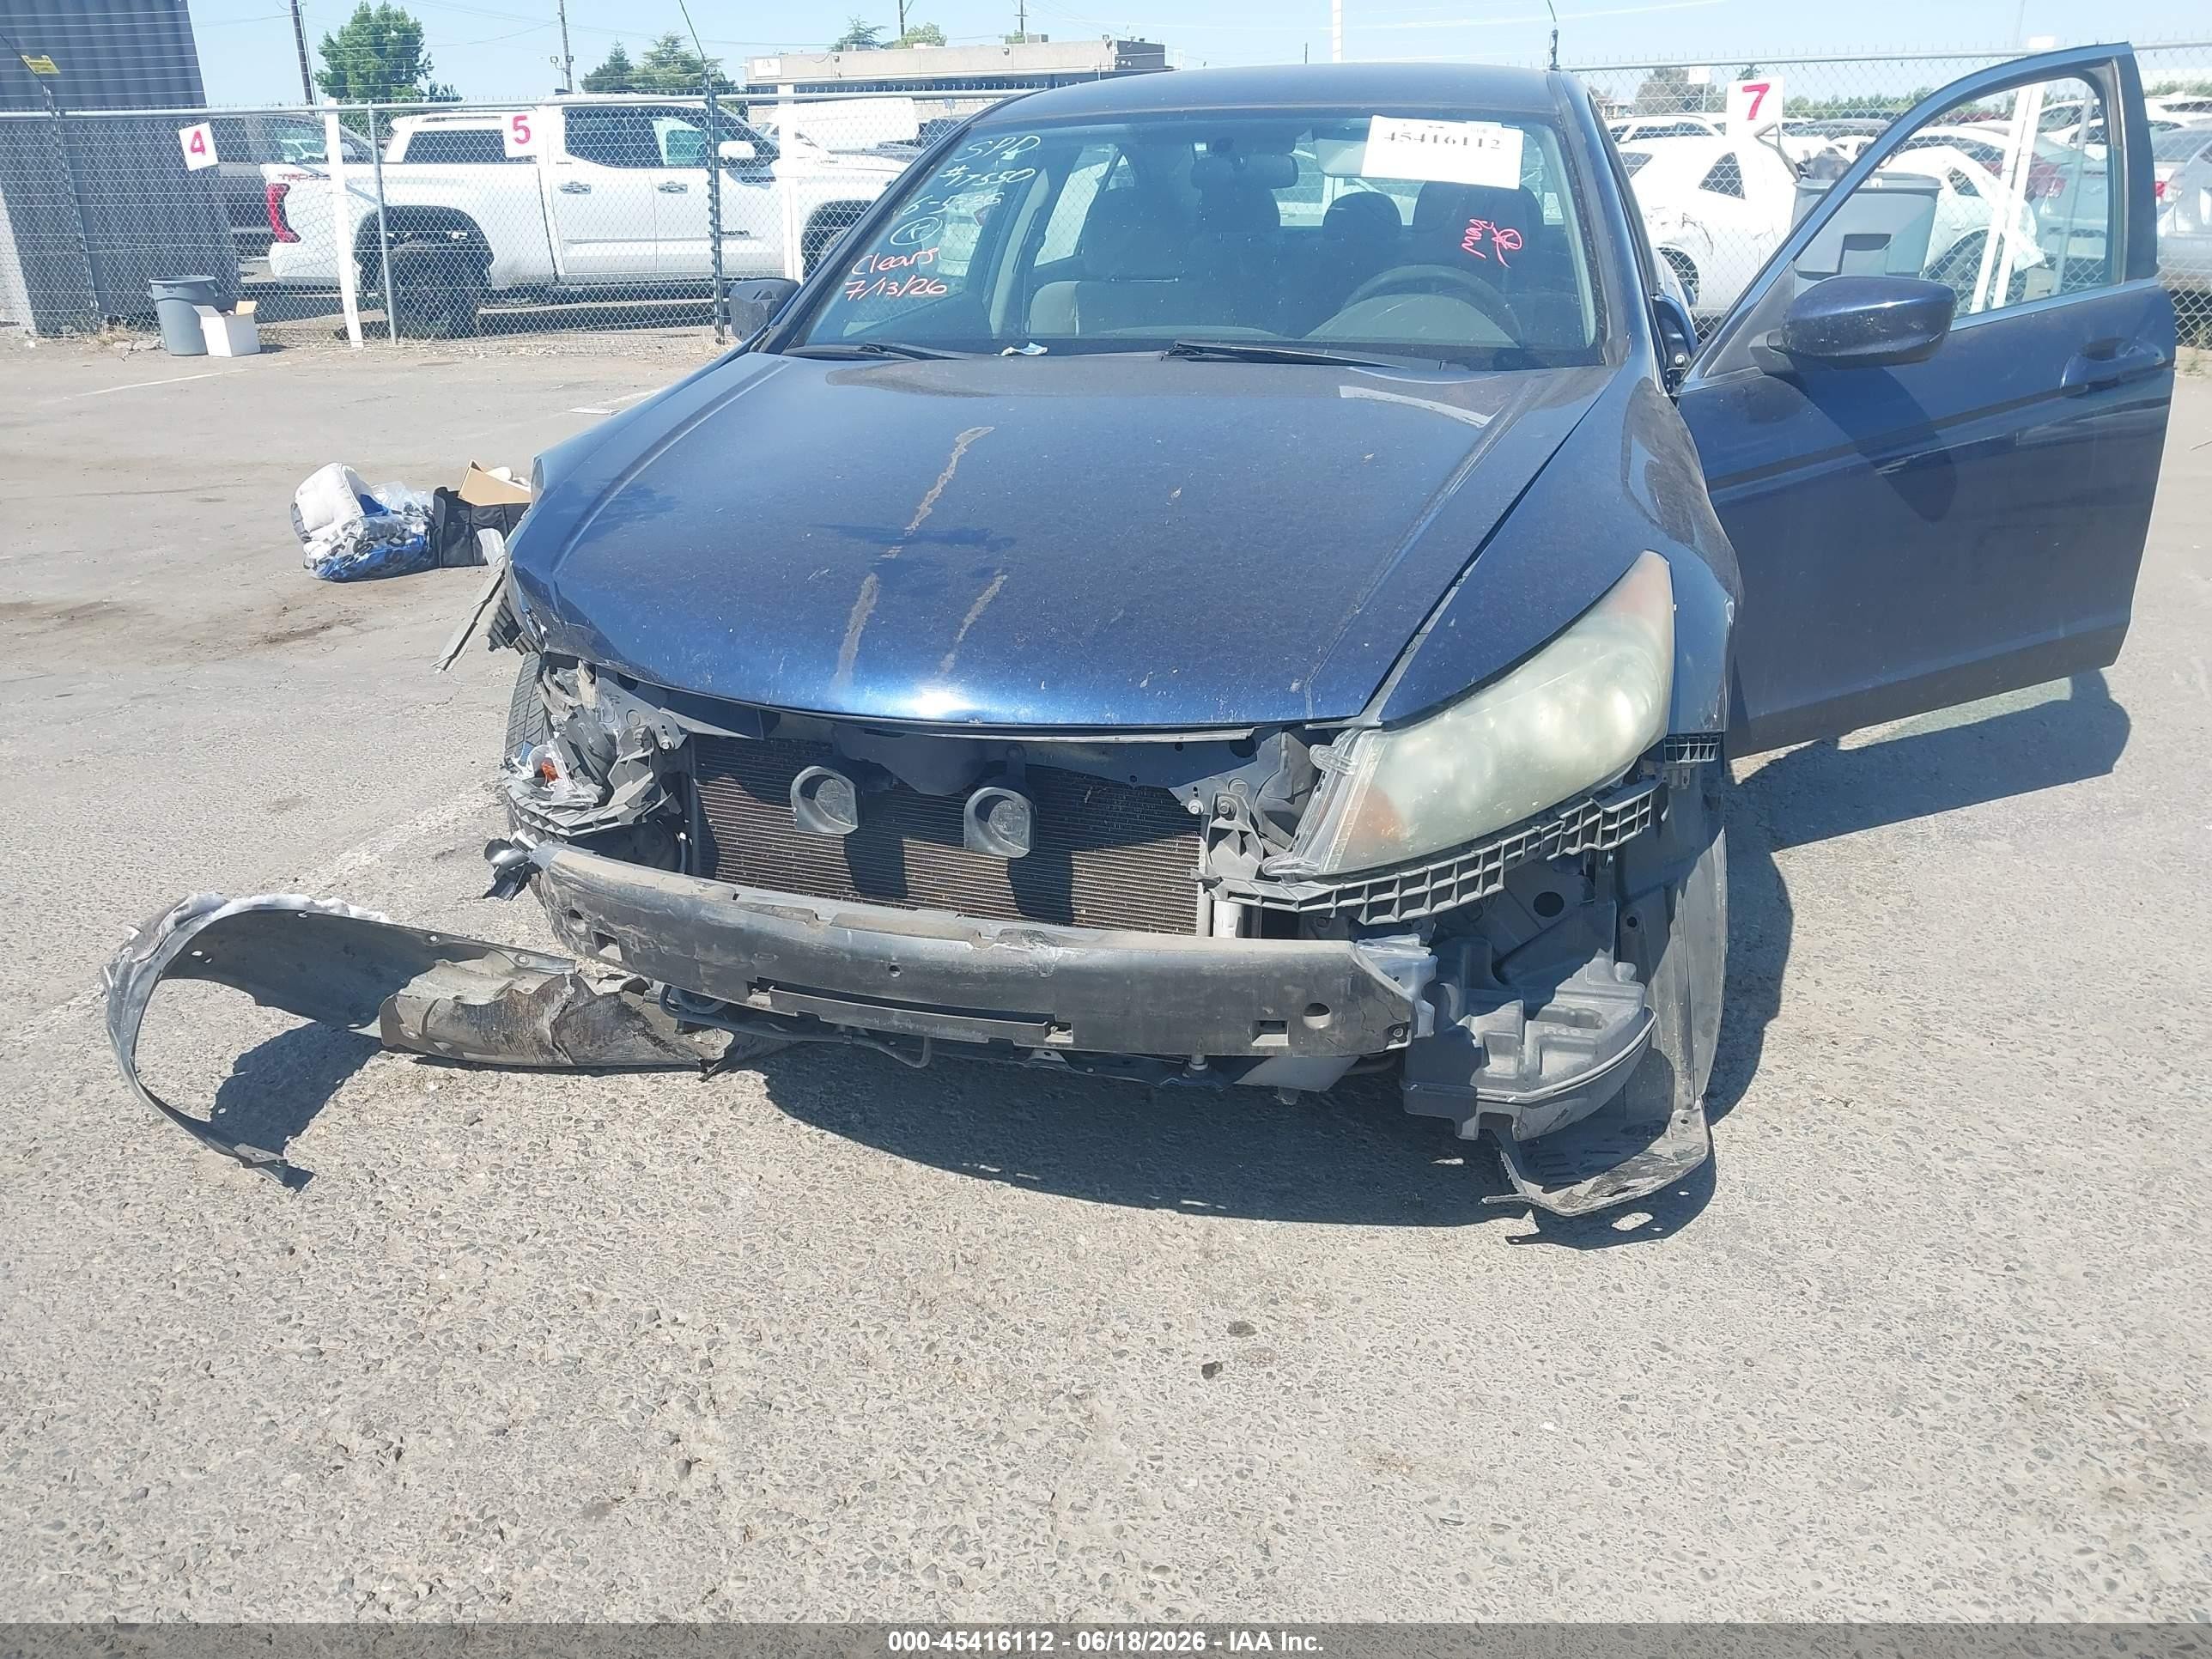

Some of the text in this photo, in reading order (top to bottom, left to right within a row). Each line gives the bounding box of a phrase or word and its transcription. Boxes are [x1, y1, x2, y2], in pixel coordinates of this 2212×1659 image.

[1741, 82, 1771, 120] 7
[191, 129, 206, 155] 4
[513, 115, 531, 144] 5
[844, 274, 947, 301] 7/13/26
